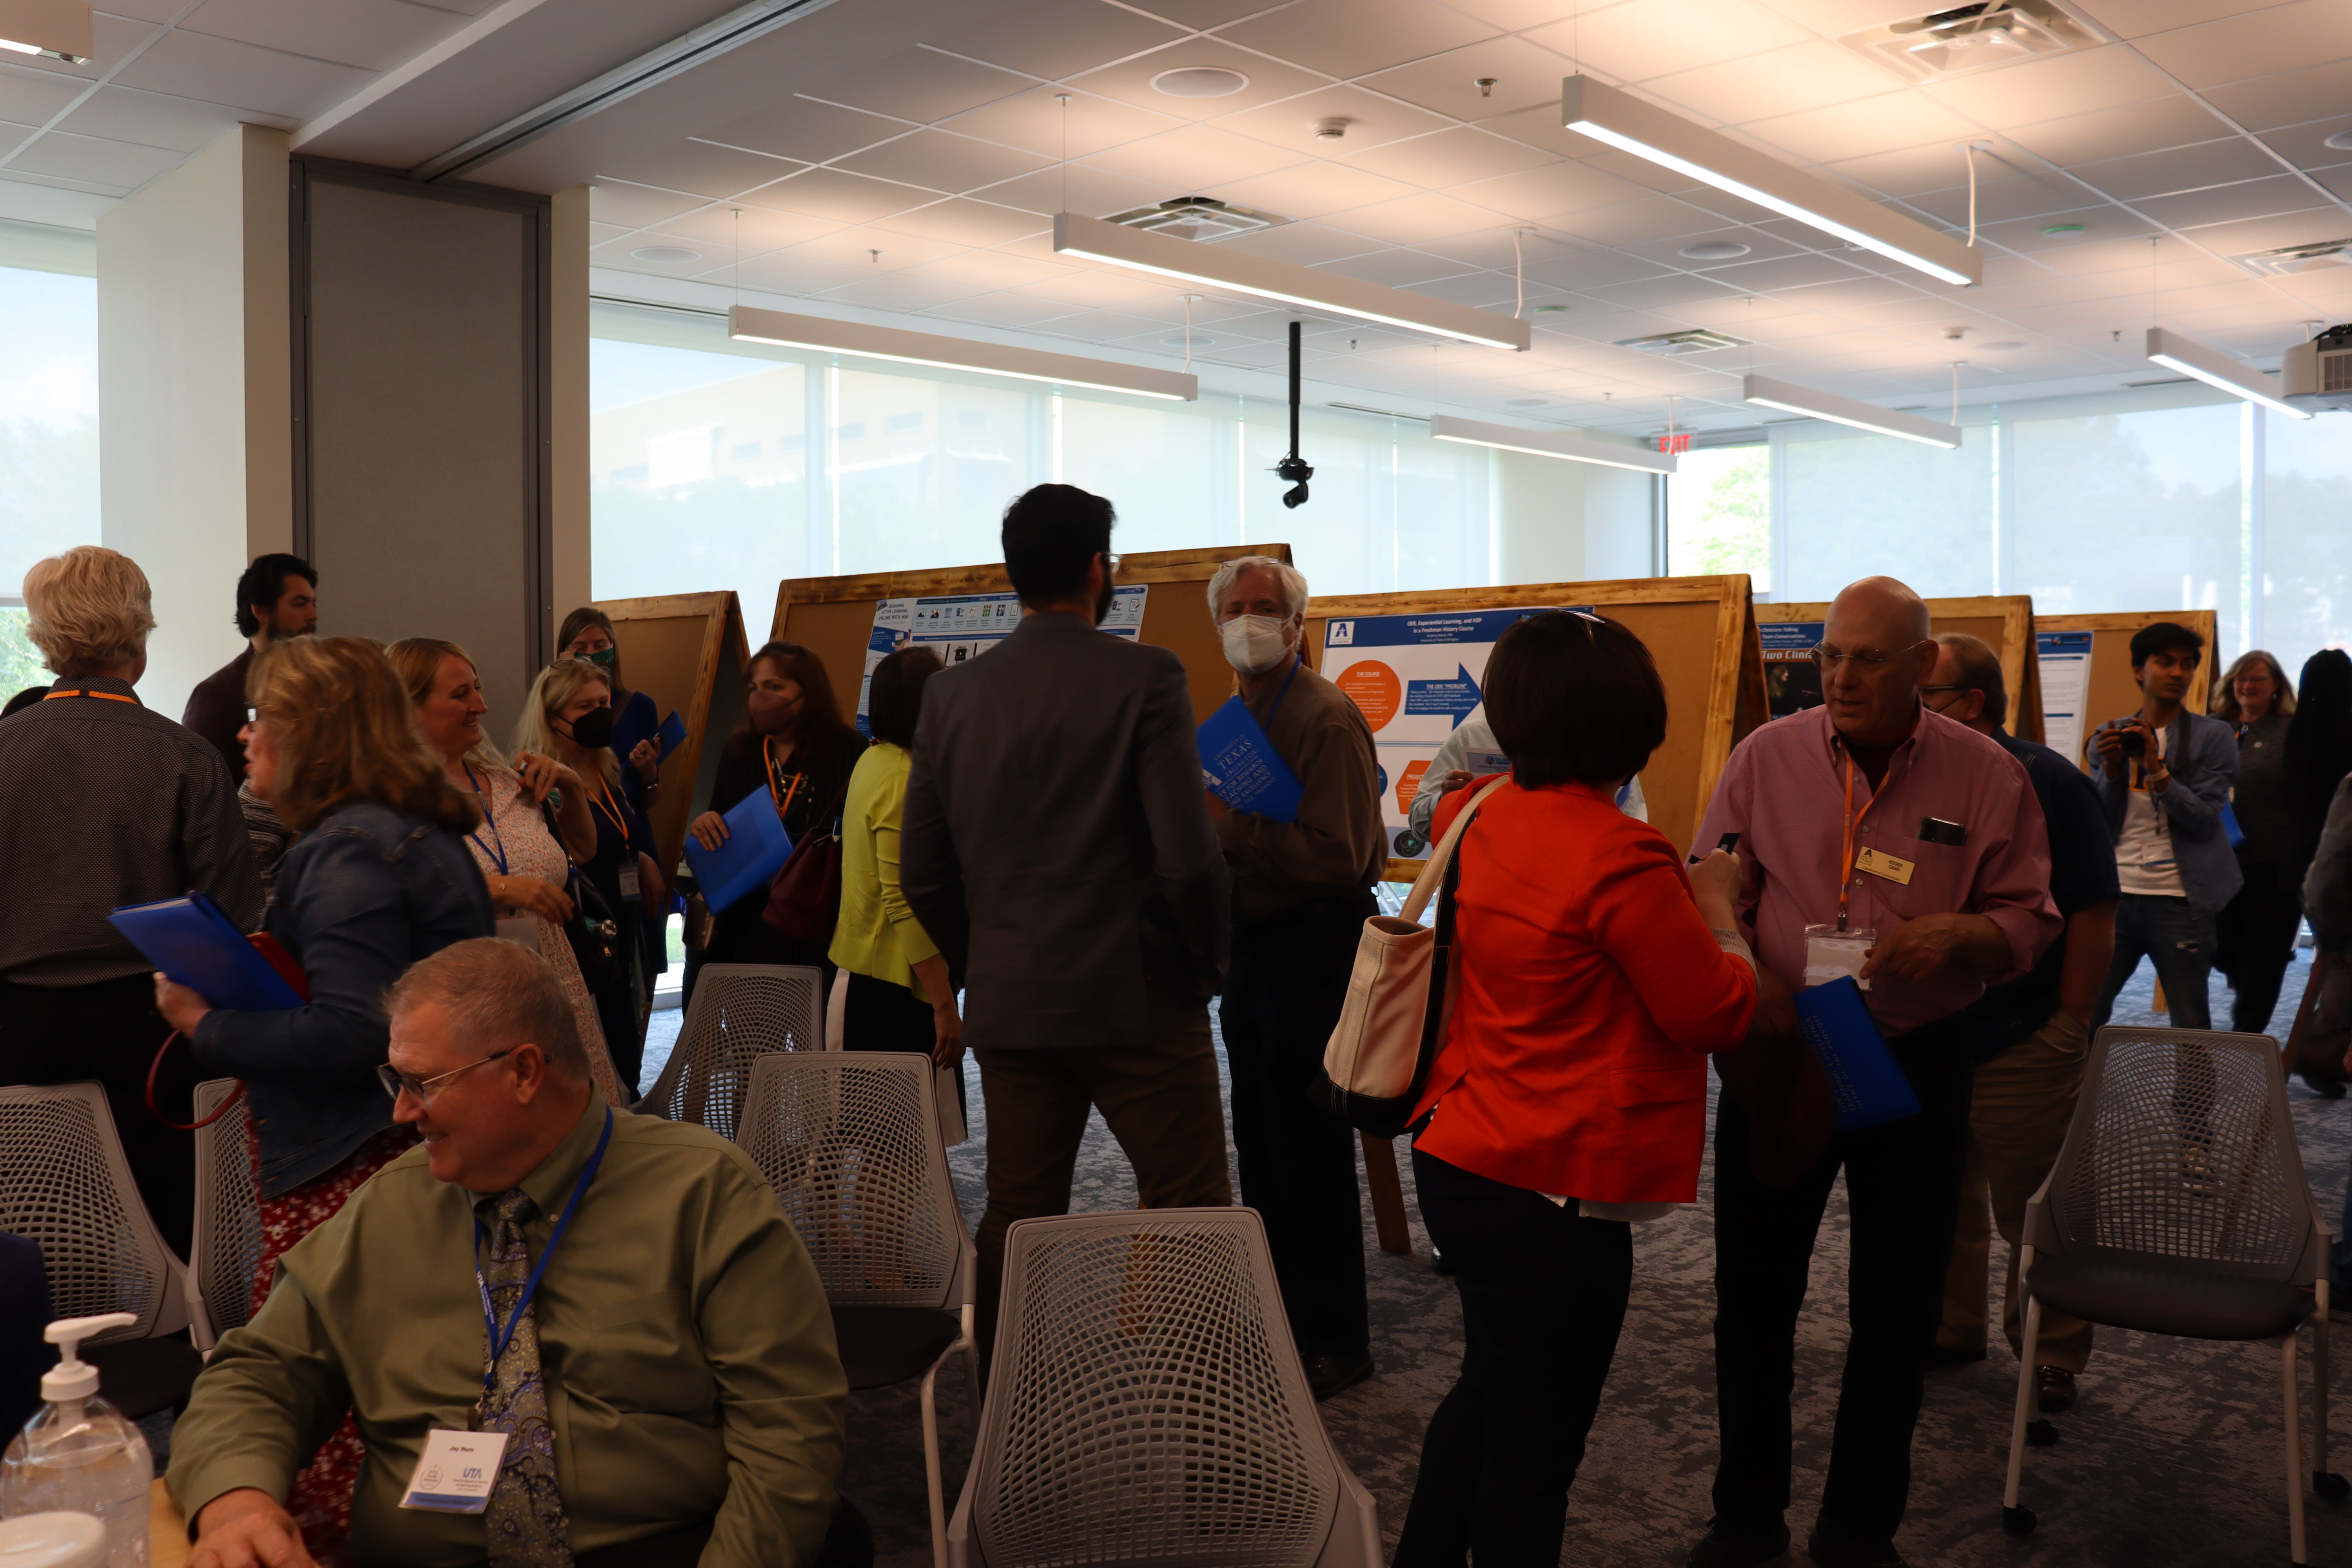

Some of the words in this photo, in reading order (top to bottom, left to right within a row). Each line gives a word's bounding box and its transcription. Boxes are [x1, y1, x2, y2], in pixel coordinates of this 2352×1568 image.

[1762, 650, 1782, 659] Two
[1217, 739, 1252, 770] TEXAS
[1225, 750, 1258, 777] ARLINGTON
[1226, 780, 1238, 791] FOR
[1237, 758, 1264, 781] RESEARCH
[1241, 770, 1272, 797] EXCELLENCE
[1252, 765, 1267, 778] AND
[1888, 860, 1903, 868] ROGER
[1881, 873, 1901, 881] Communication
[1804, 1017, 1833, 1066] EXCELLENCE
[1812, 1015, 1833, 1049] PROVOST
[1841, 1071, 1848, 1080] OF
[1832, 1070, 1856, 1111] LEARNING
[1847, 1084, 1863, 1109] OFFICE
[1837, 1098, 1847, 1113] ON
[463, 1467, 482, 1479] UTA
